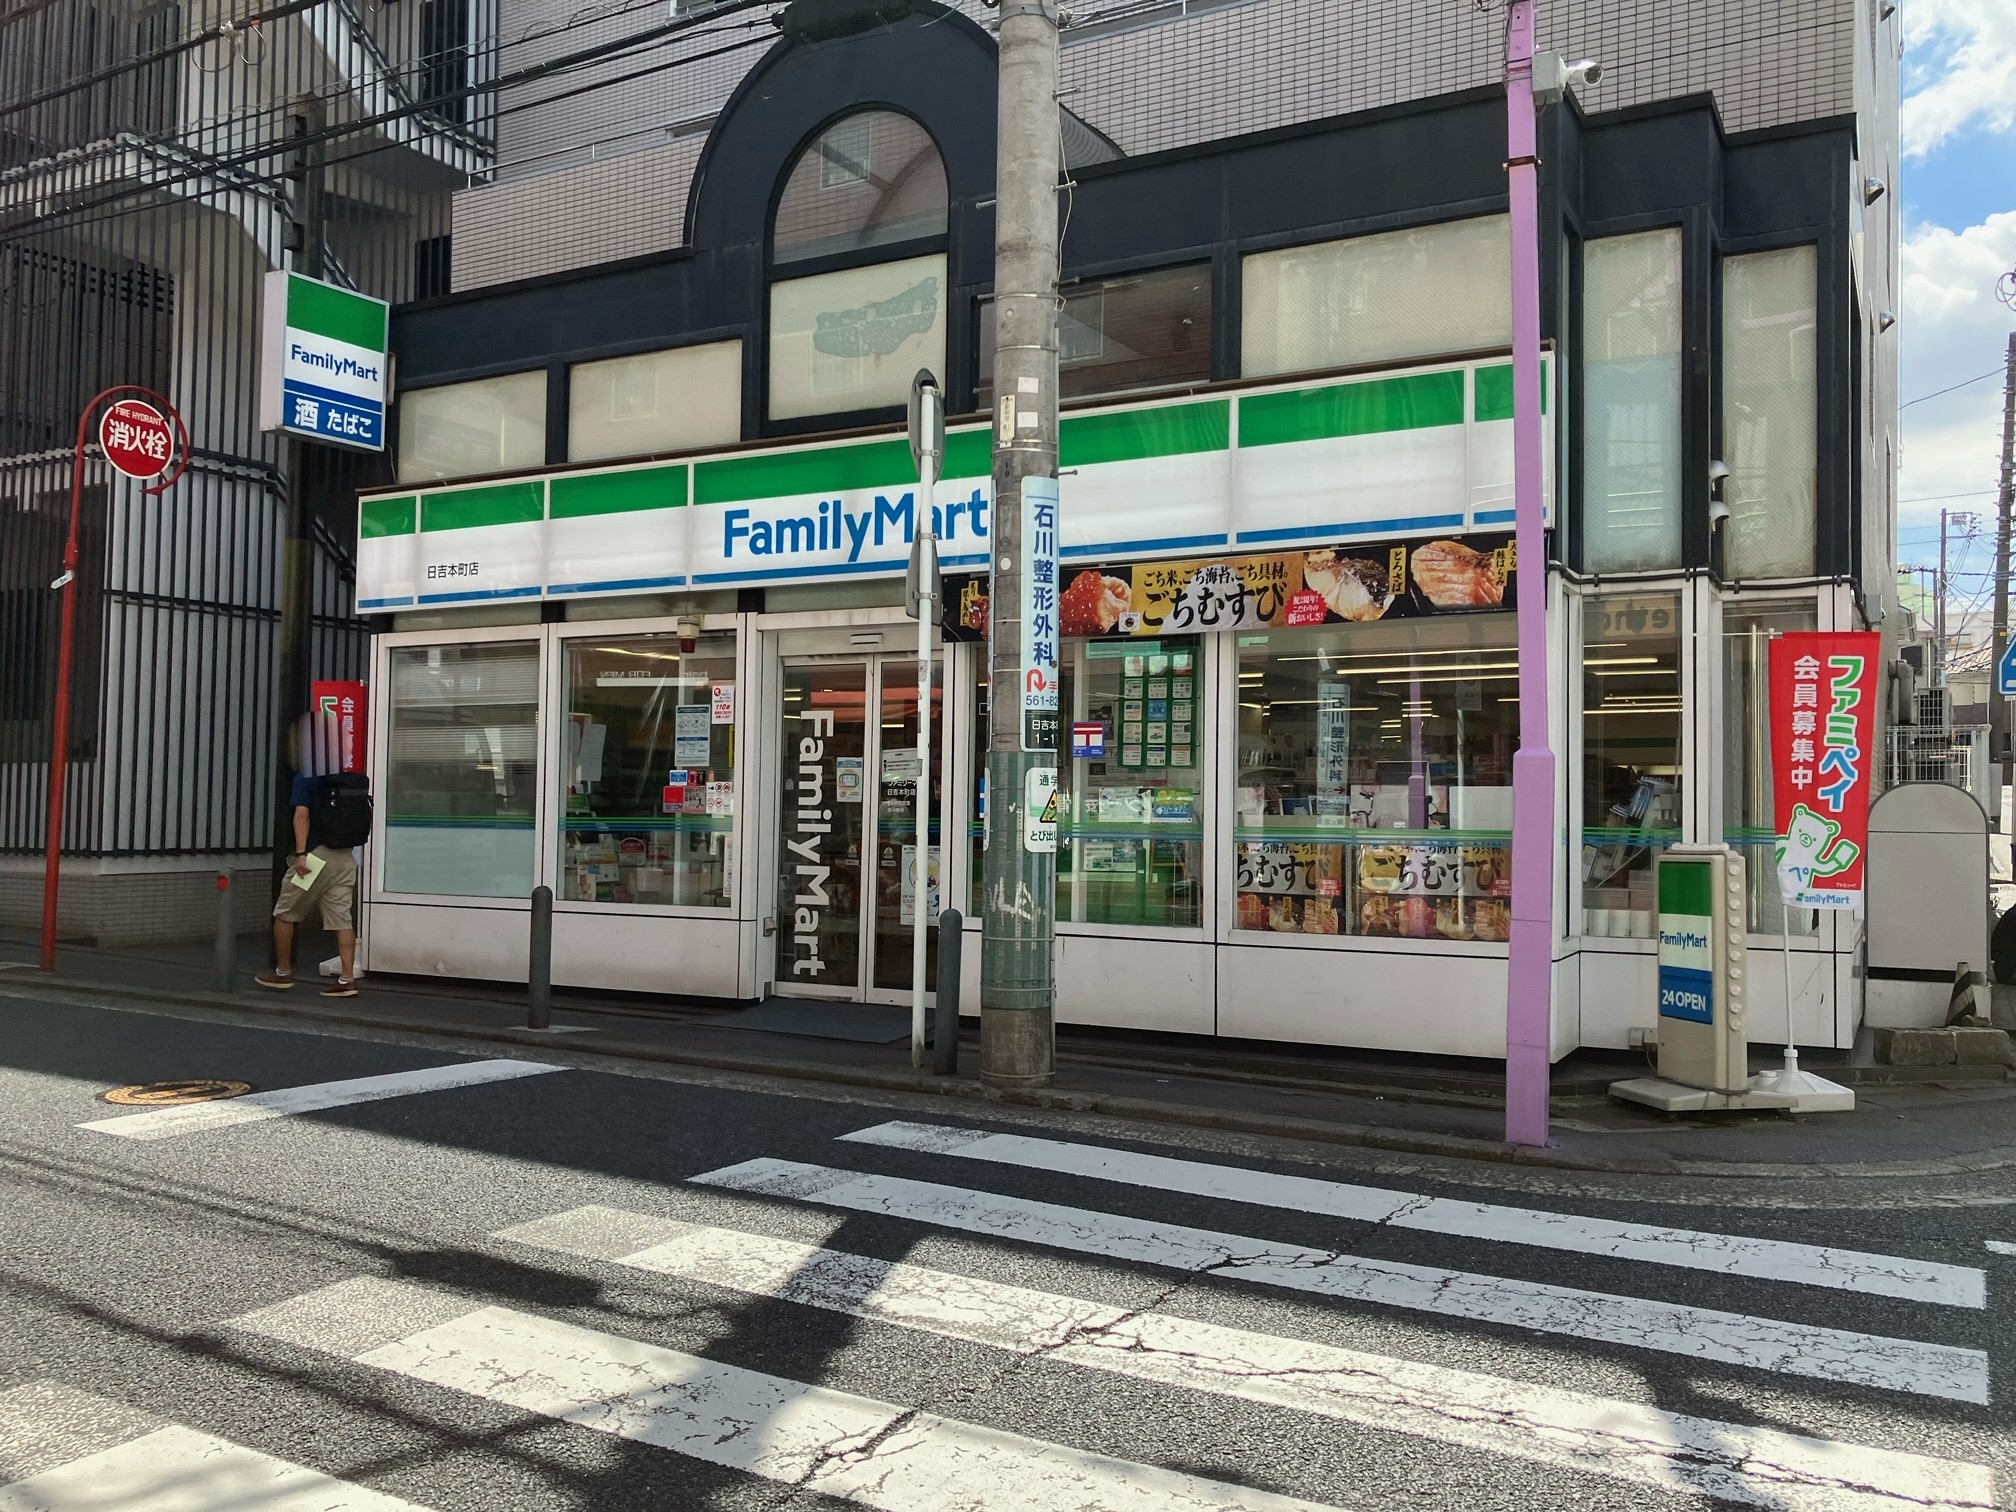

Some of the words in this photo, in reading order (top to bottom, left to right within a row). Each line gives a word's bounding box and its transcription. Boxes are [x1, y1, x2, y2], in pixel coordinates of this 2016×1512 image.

[291, 344, 378, 382] FamilyMart
[115, 406, 131, 418] FIRE
[131, 411, 162, 426] HYDRANT
[294, 397, 320, 430] 酒
[327, 408, 372, 438] たばこ
[107, 418, 168, 460] 消火栓
[427, 562, 479, 580] 日吉本町店
[1033, 503, 1055, 667] 石川整形外科
[1391, 551, 1403, 593] とろさば
[1142, 582, 1288, 629] ごちむすび
[1790, 655, 1821, 790] 会員募集中
[1818, 656, 1864, 812] ファミペイ
[787, 710, 834, 976] FamilyMart
[1660, 930, 1708, 951] FamilyMart
